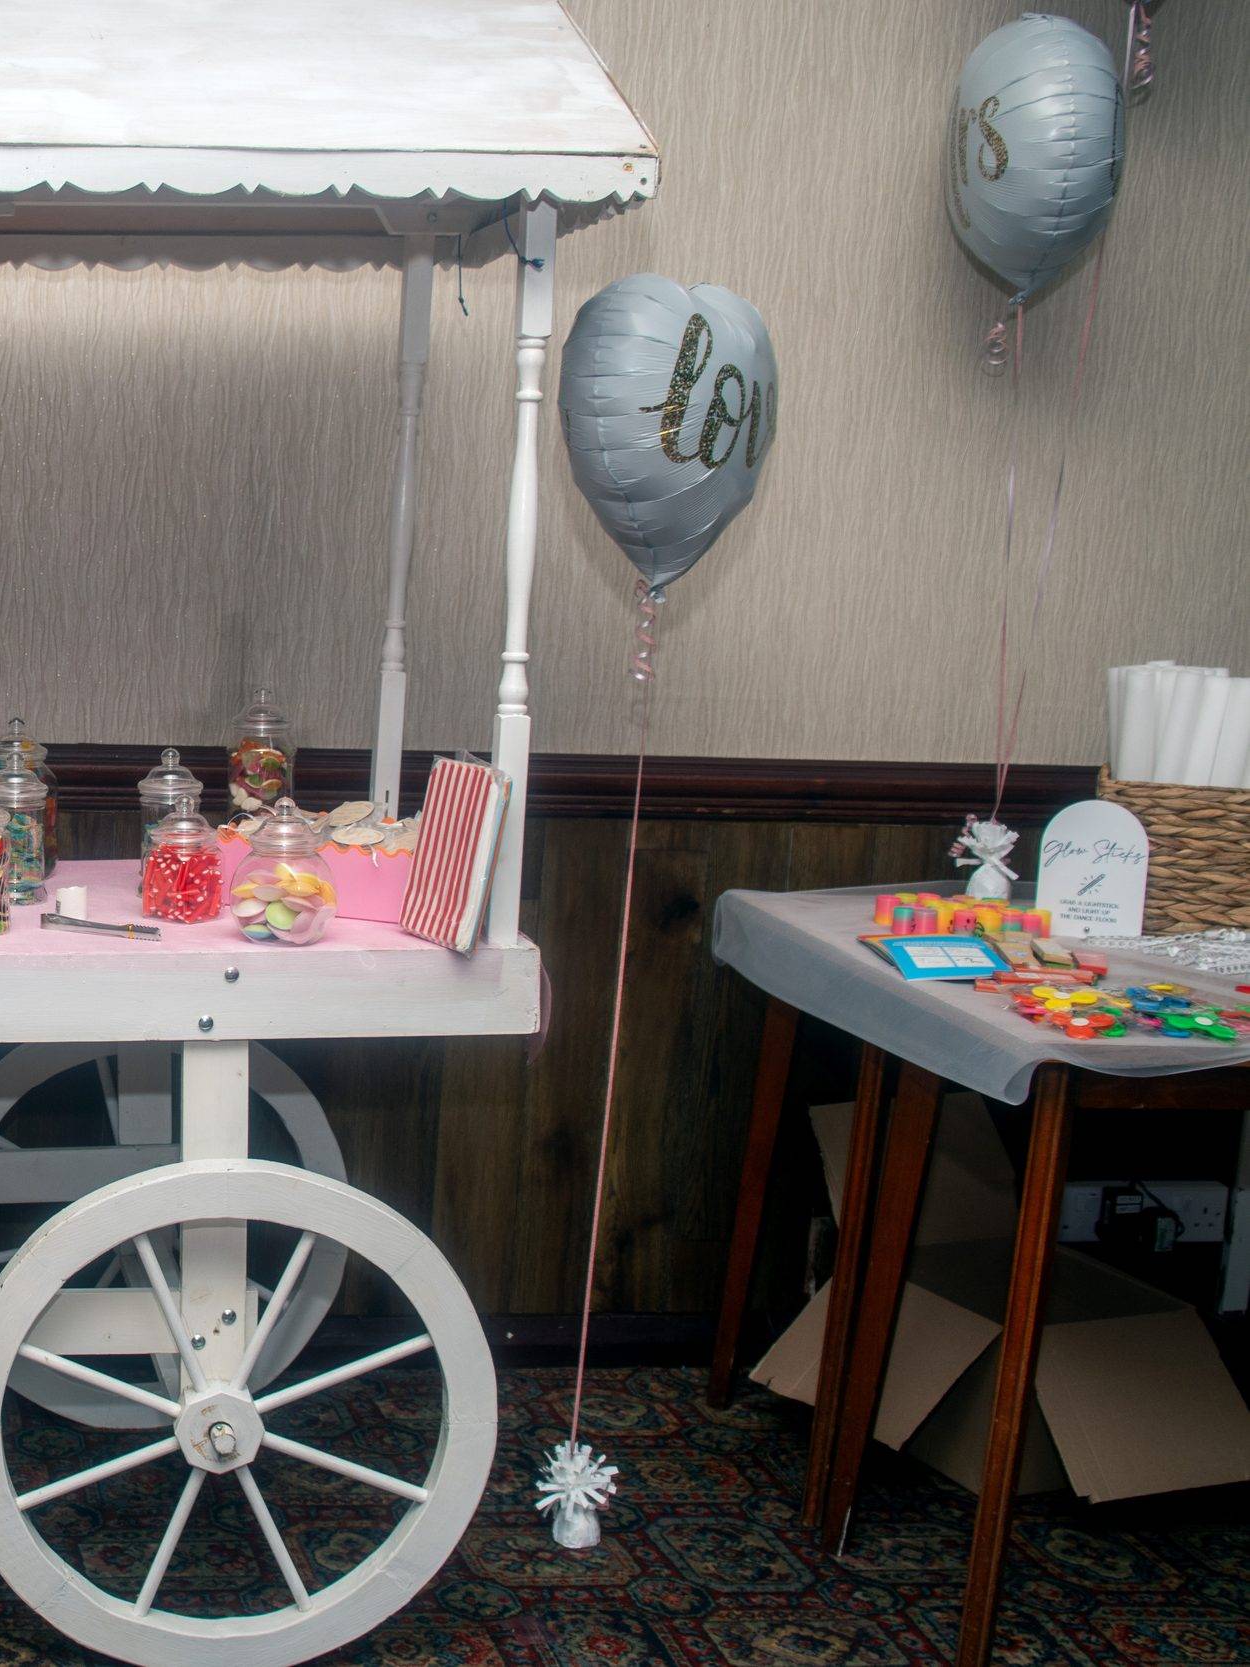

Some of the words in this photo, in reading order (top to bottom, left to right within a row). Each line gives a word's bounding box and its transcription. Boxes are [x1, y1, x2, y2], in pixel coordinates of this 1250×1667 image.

[638, 313, 779, 469] lov
[1043, 840, 1089, 867] Glow
[1092, 839, 1147, 865] Sticks
